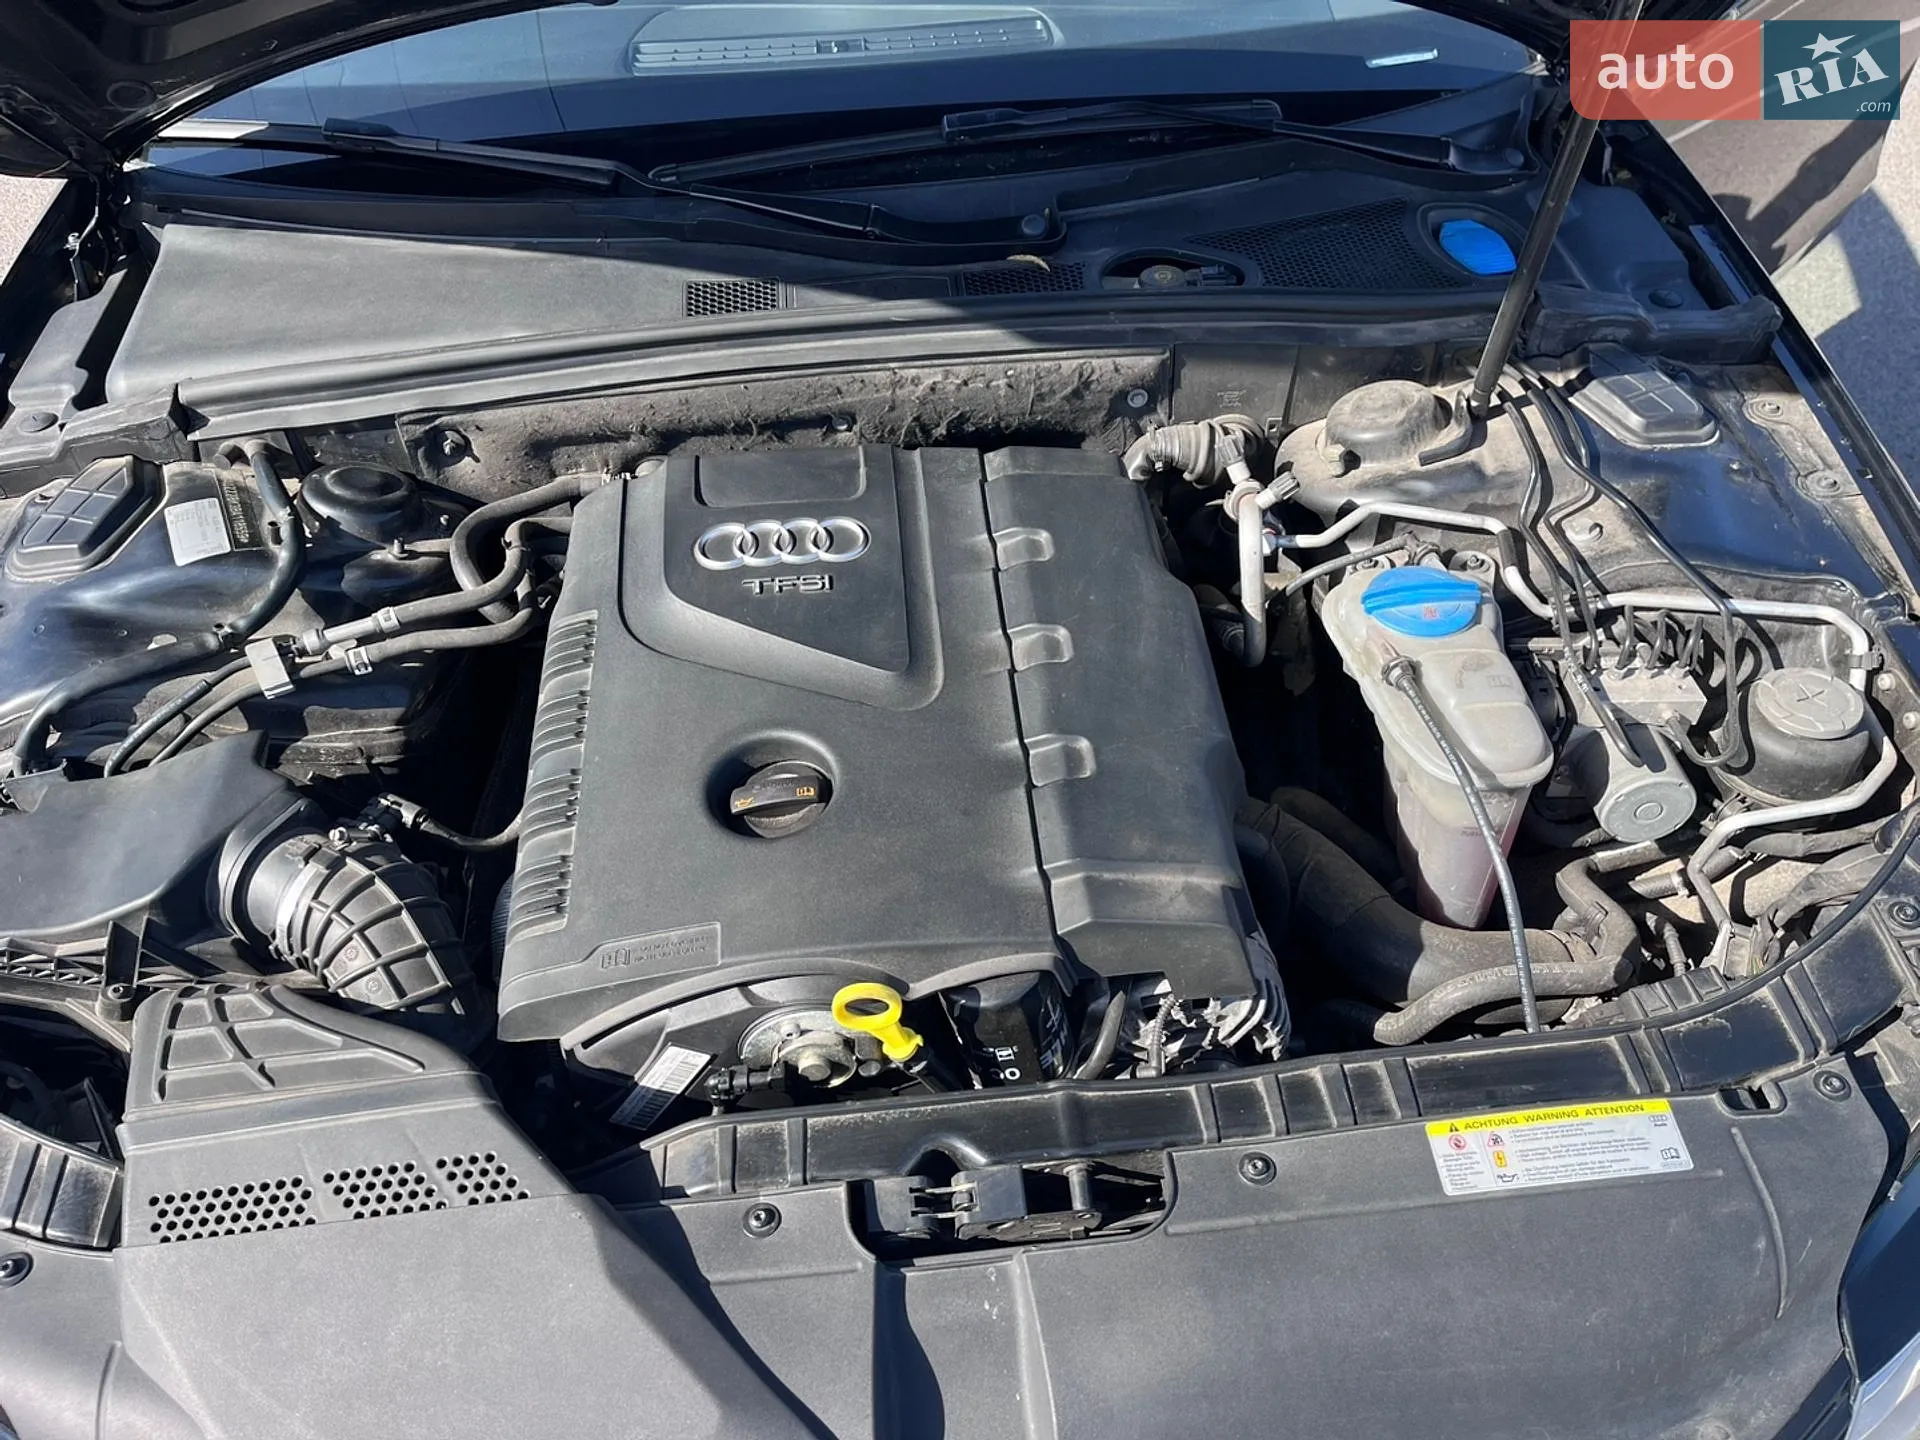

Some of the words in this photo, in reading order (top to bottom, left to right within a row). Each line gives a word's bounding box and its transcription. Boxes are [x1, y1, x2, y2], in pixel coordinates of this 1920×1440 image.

[742, 574, 833, 596] TFSI
[1464, 1116, 1519, 1130] ACHTUNG
[1523, 1109, 1579, 1123] WARNING
[1585, 1103, 1645, 1117] ATTENTION
